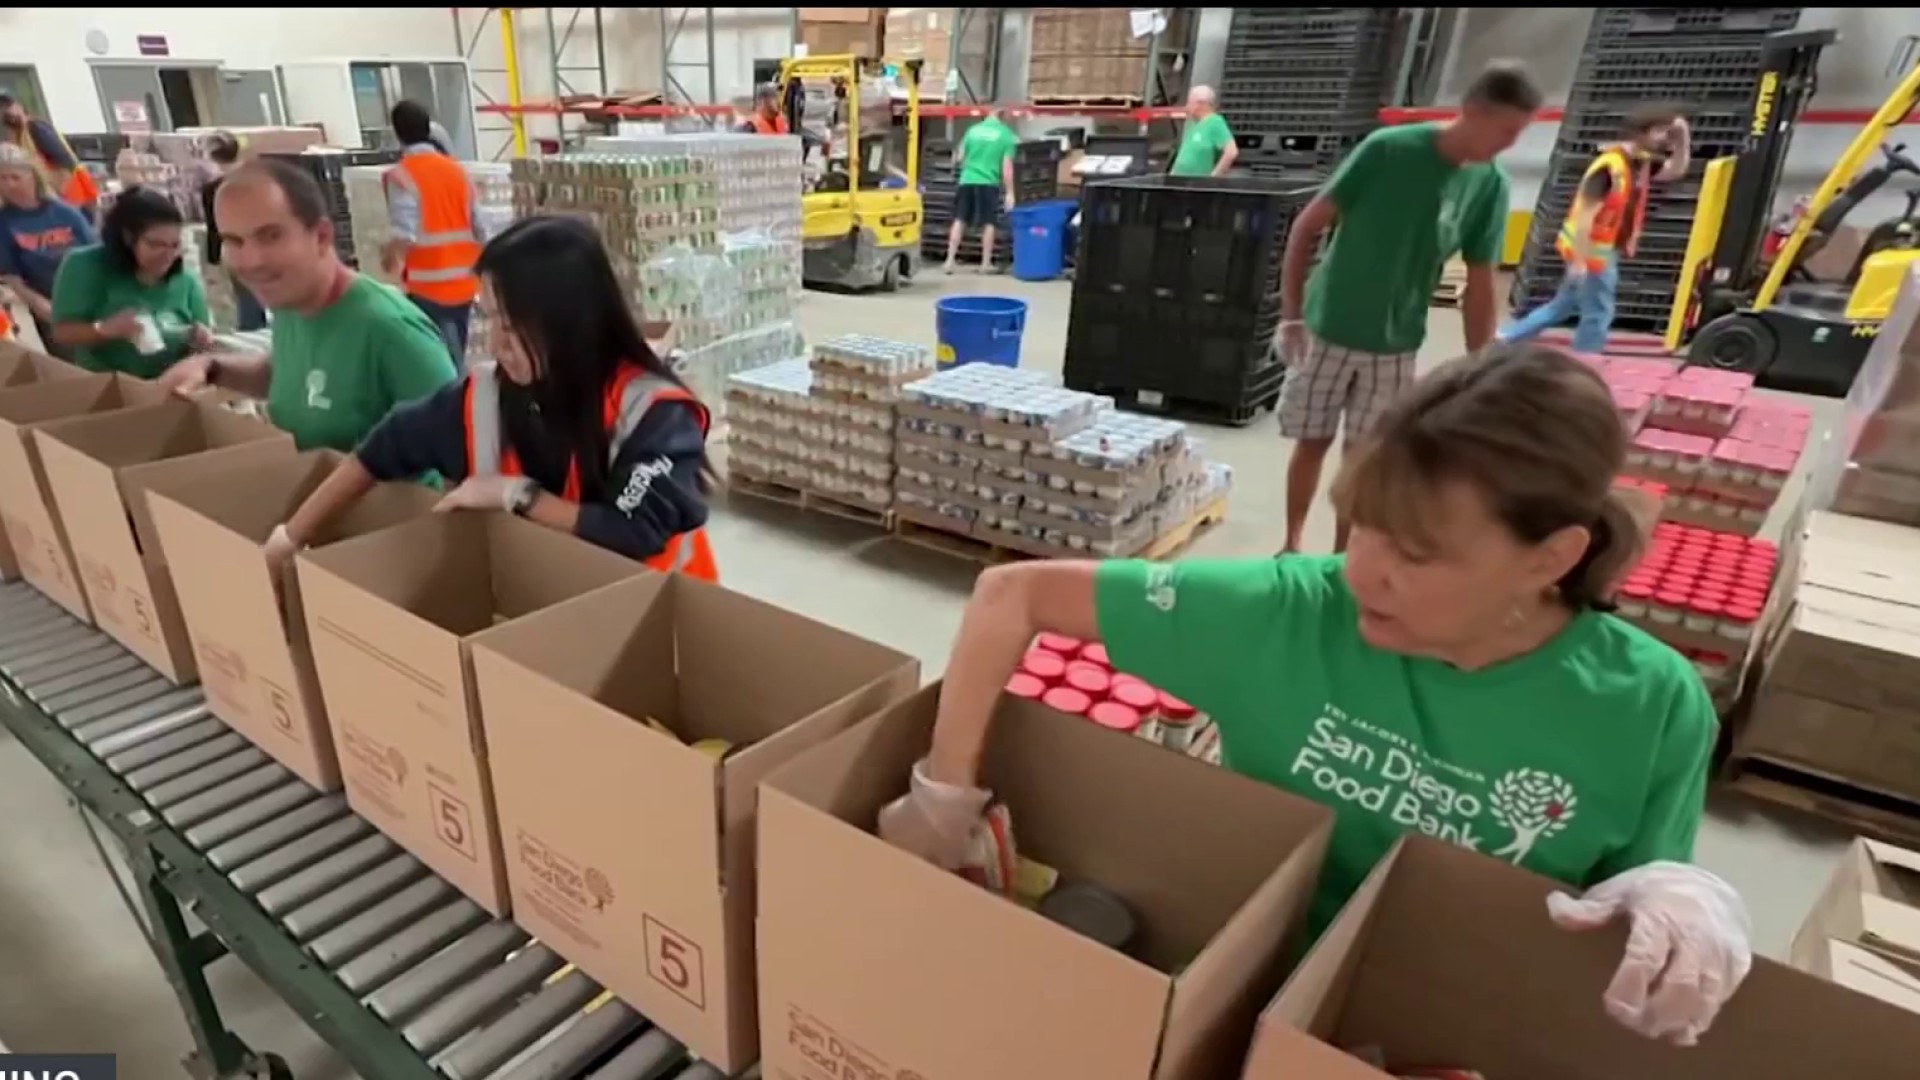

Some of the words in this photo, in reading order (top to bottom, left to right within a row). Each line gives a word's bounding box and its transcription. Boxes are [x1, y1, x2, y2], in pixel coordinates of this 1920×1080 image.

[271, 690, 291, 730] 5
[1307, 716, 1375, 771] San
[1380, 747, 1482, 818] Diego
[442, 798, 463, 845] 5
[1291, 746, 1391, 813] Food
[1390, 781, 1484, 850] Bank
[661, 935, 689, 988] 5
[789, 1030, 837, 1075] Food
